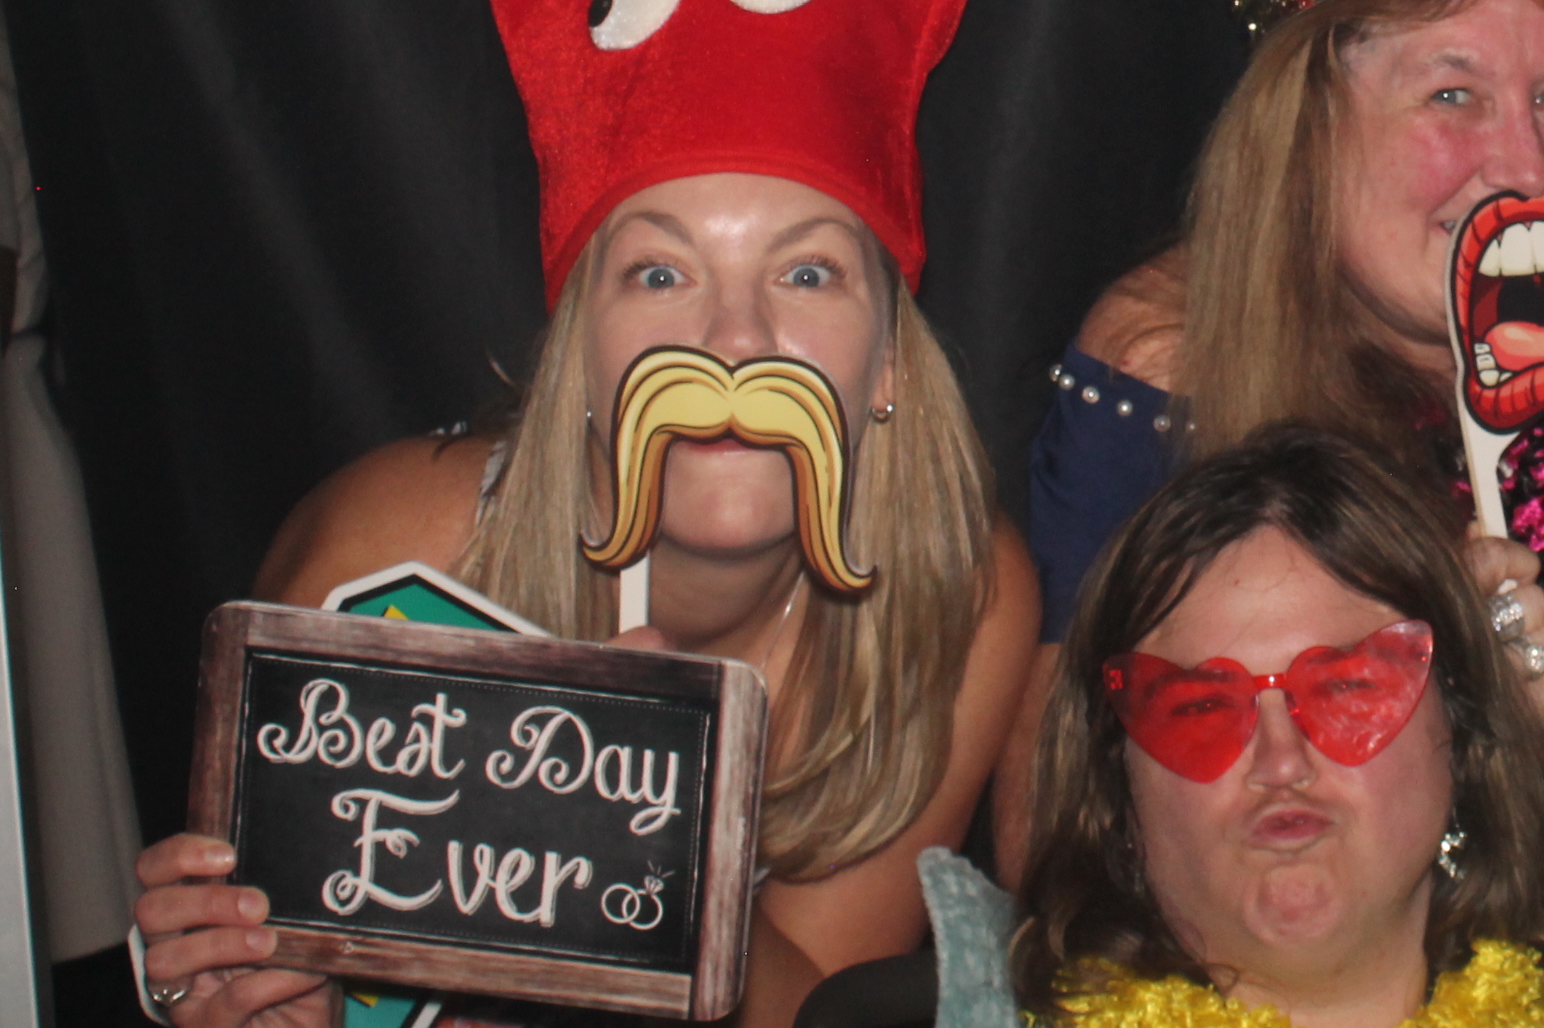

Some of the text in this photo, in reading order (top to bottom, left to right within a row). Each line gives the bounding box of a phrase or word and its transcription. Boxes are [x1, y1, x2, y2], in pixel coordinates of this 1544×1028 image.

[257, 678, 681, 836] Best Day
[322, 787, 593, 929] Ever
